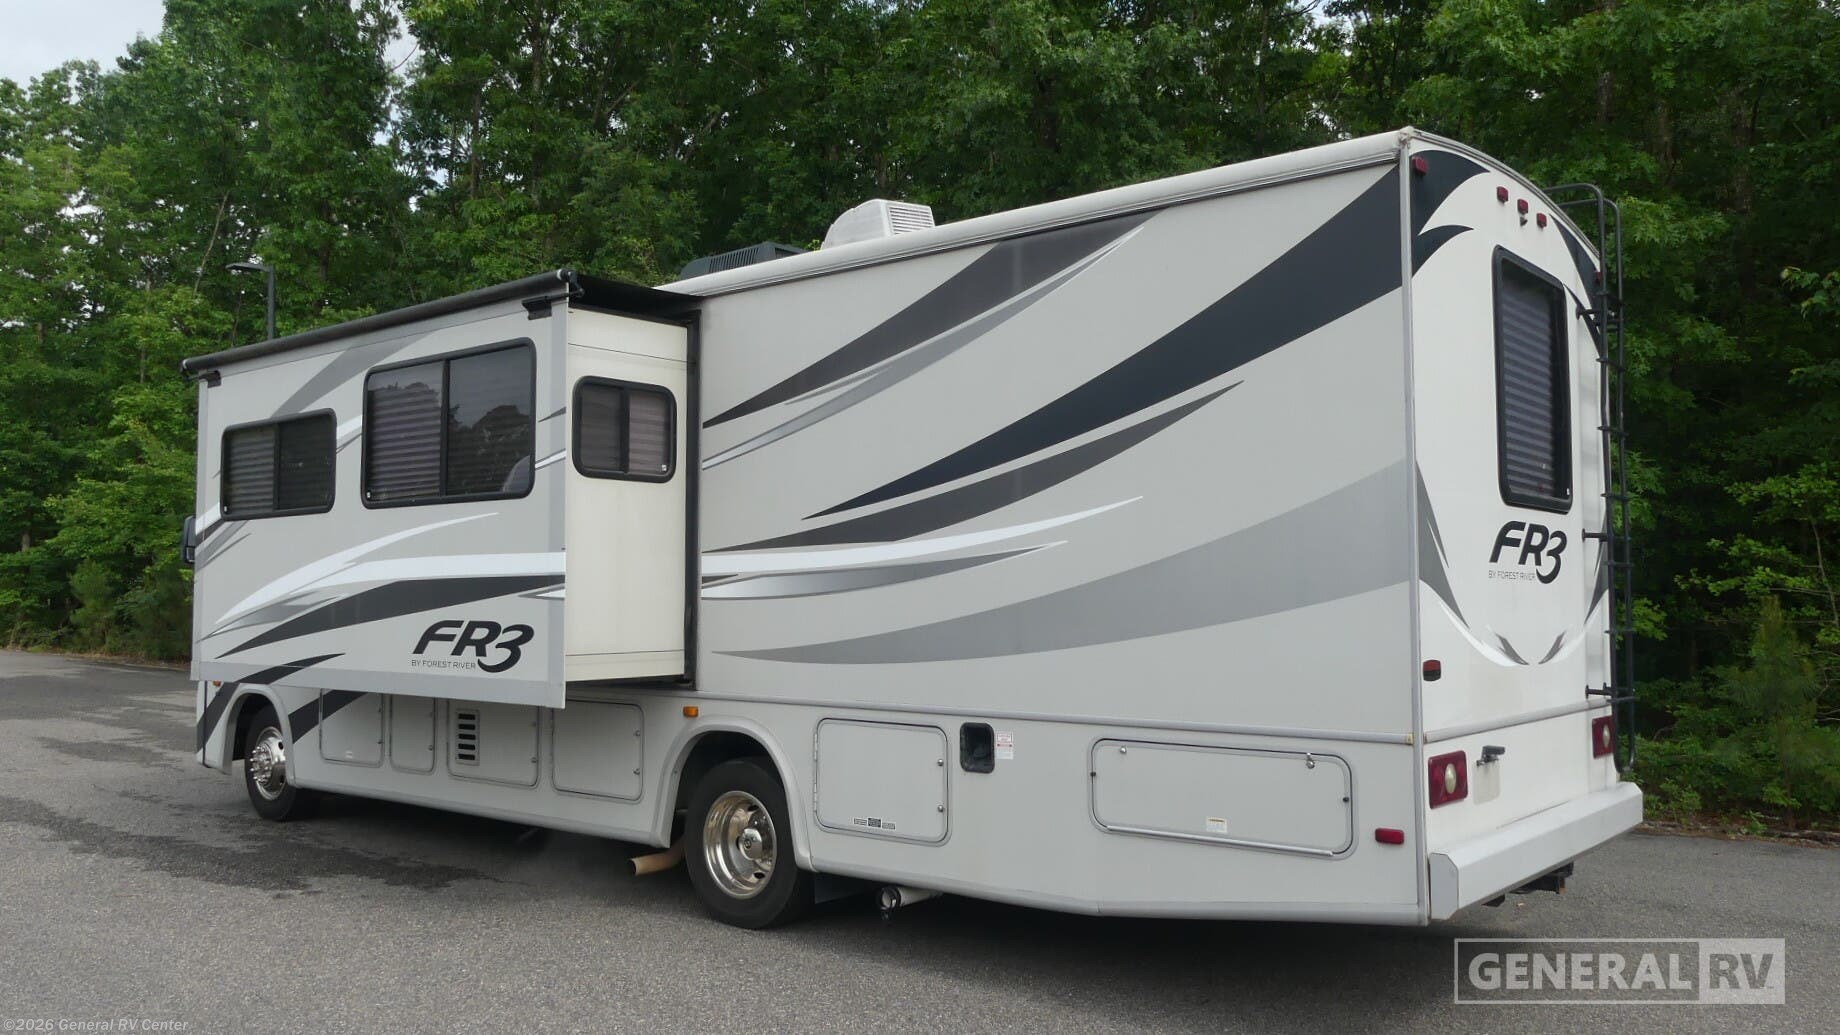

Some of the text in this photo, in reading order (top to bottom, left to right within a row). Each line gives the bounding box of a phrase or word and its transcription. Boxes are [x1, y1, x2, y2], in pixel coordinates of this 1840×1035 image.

[1489, 520, 1567, 584] FR3
[411, 659, 476, 670] BY FOREST RIVER
[412, 619, 535, 673] FR3
